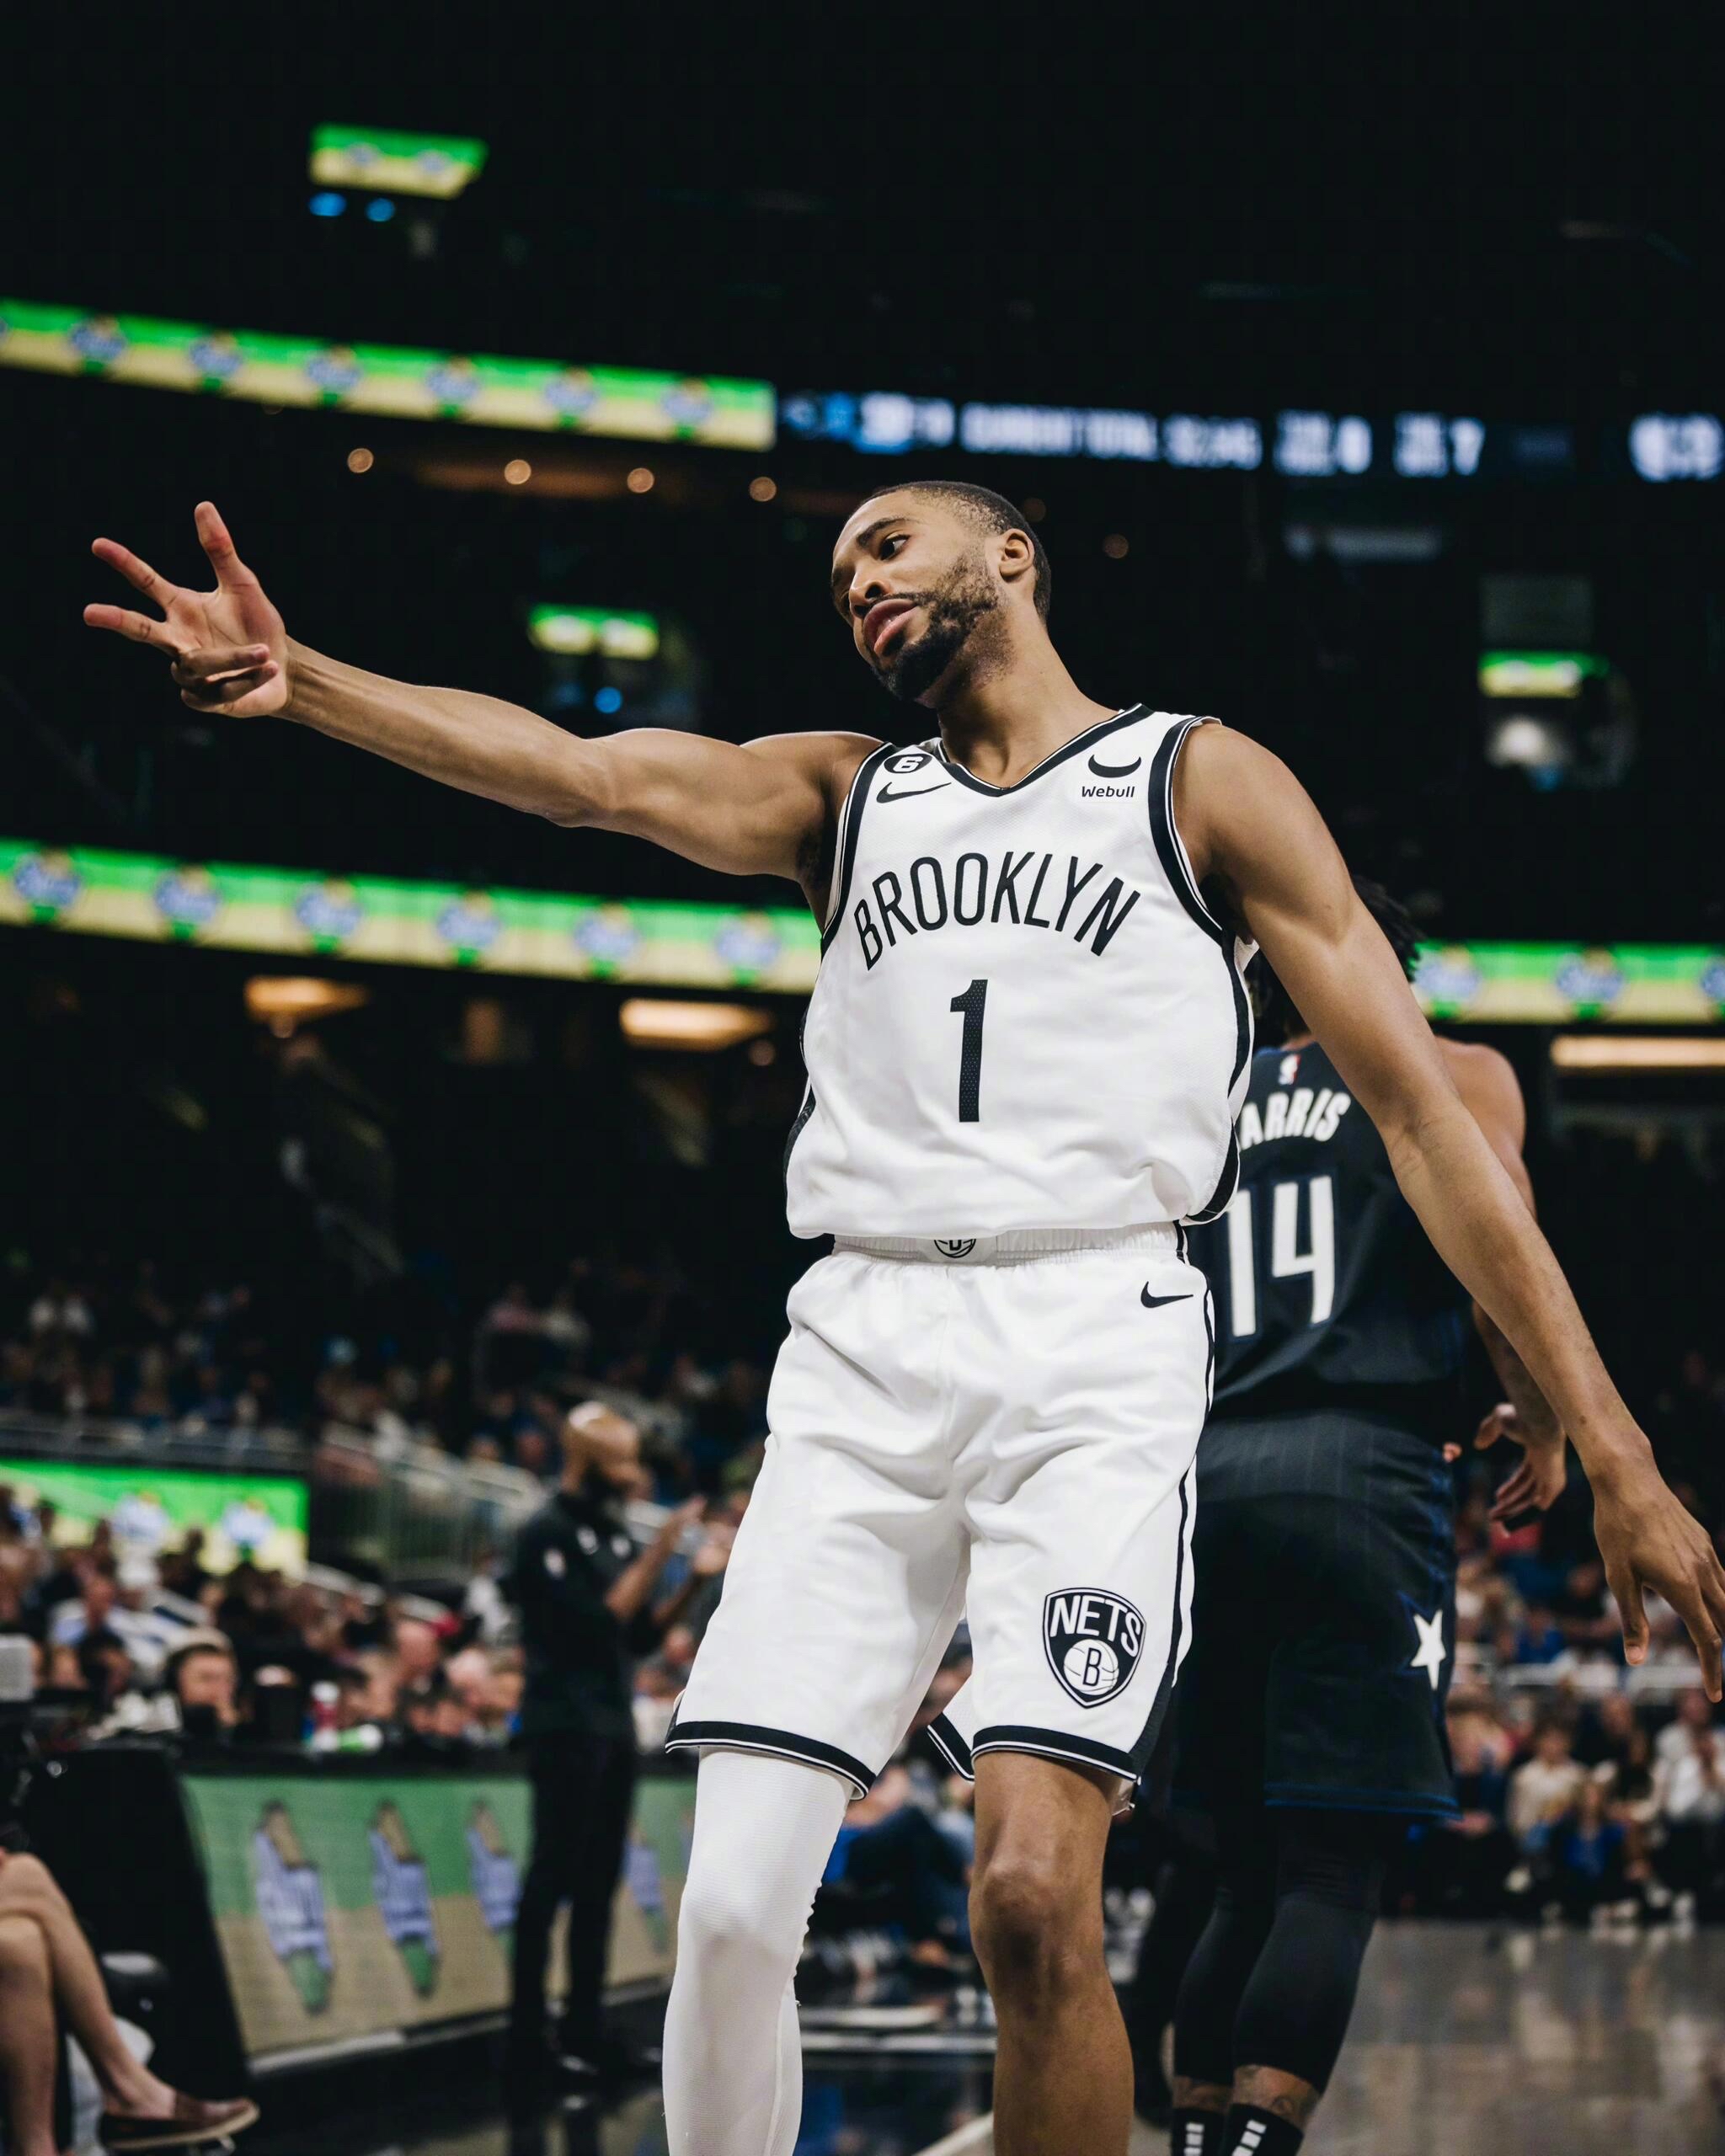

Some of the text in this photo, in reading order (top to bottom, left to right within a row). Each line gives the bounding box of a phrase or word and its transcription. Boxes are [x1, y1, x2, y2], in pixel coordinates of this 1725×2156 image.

[893, 756, 924, 772] 6
[1081, 786, 1135, 798] Webull
[854, 851, 1140, 970] BROOKLYN
[950, 979, 988, 1123] 1
[1239, 1088, 1351, 1151] ARRIS
[1226, 1176, 1336, 1337] 14
[1049, 1594, 1141, 1657] NETS
[1083, 1647, 1102, 1686] B
